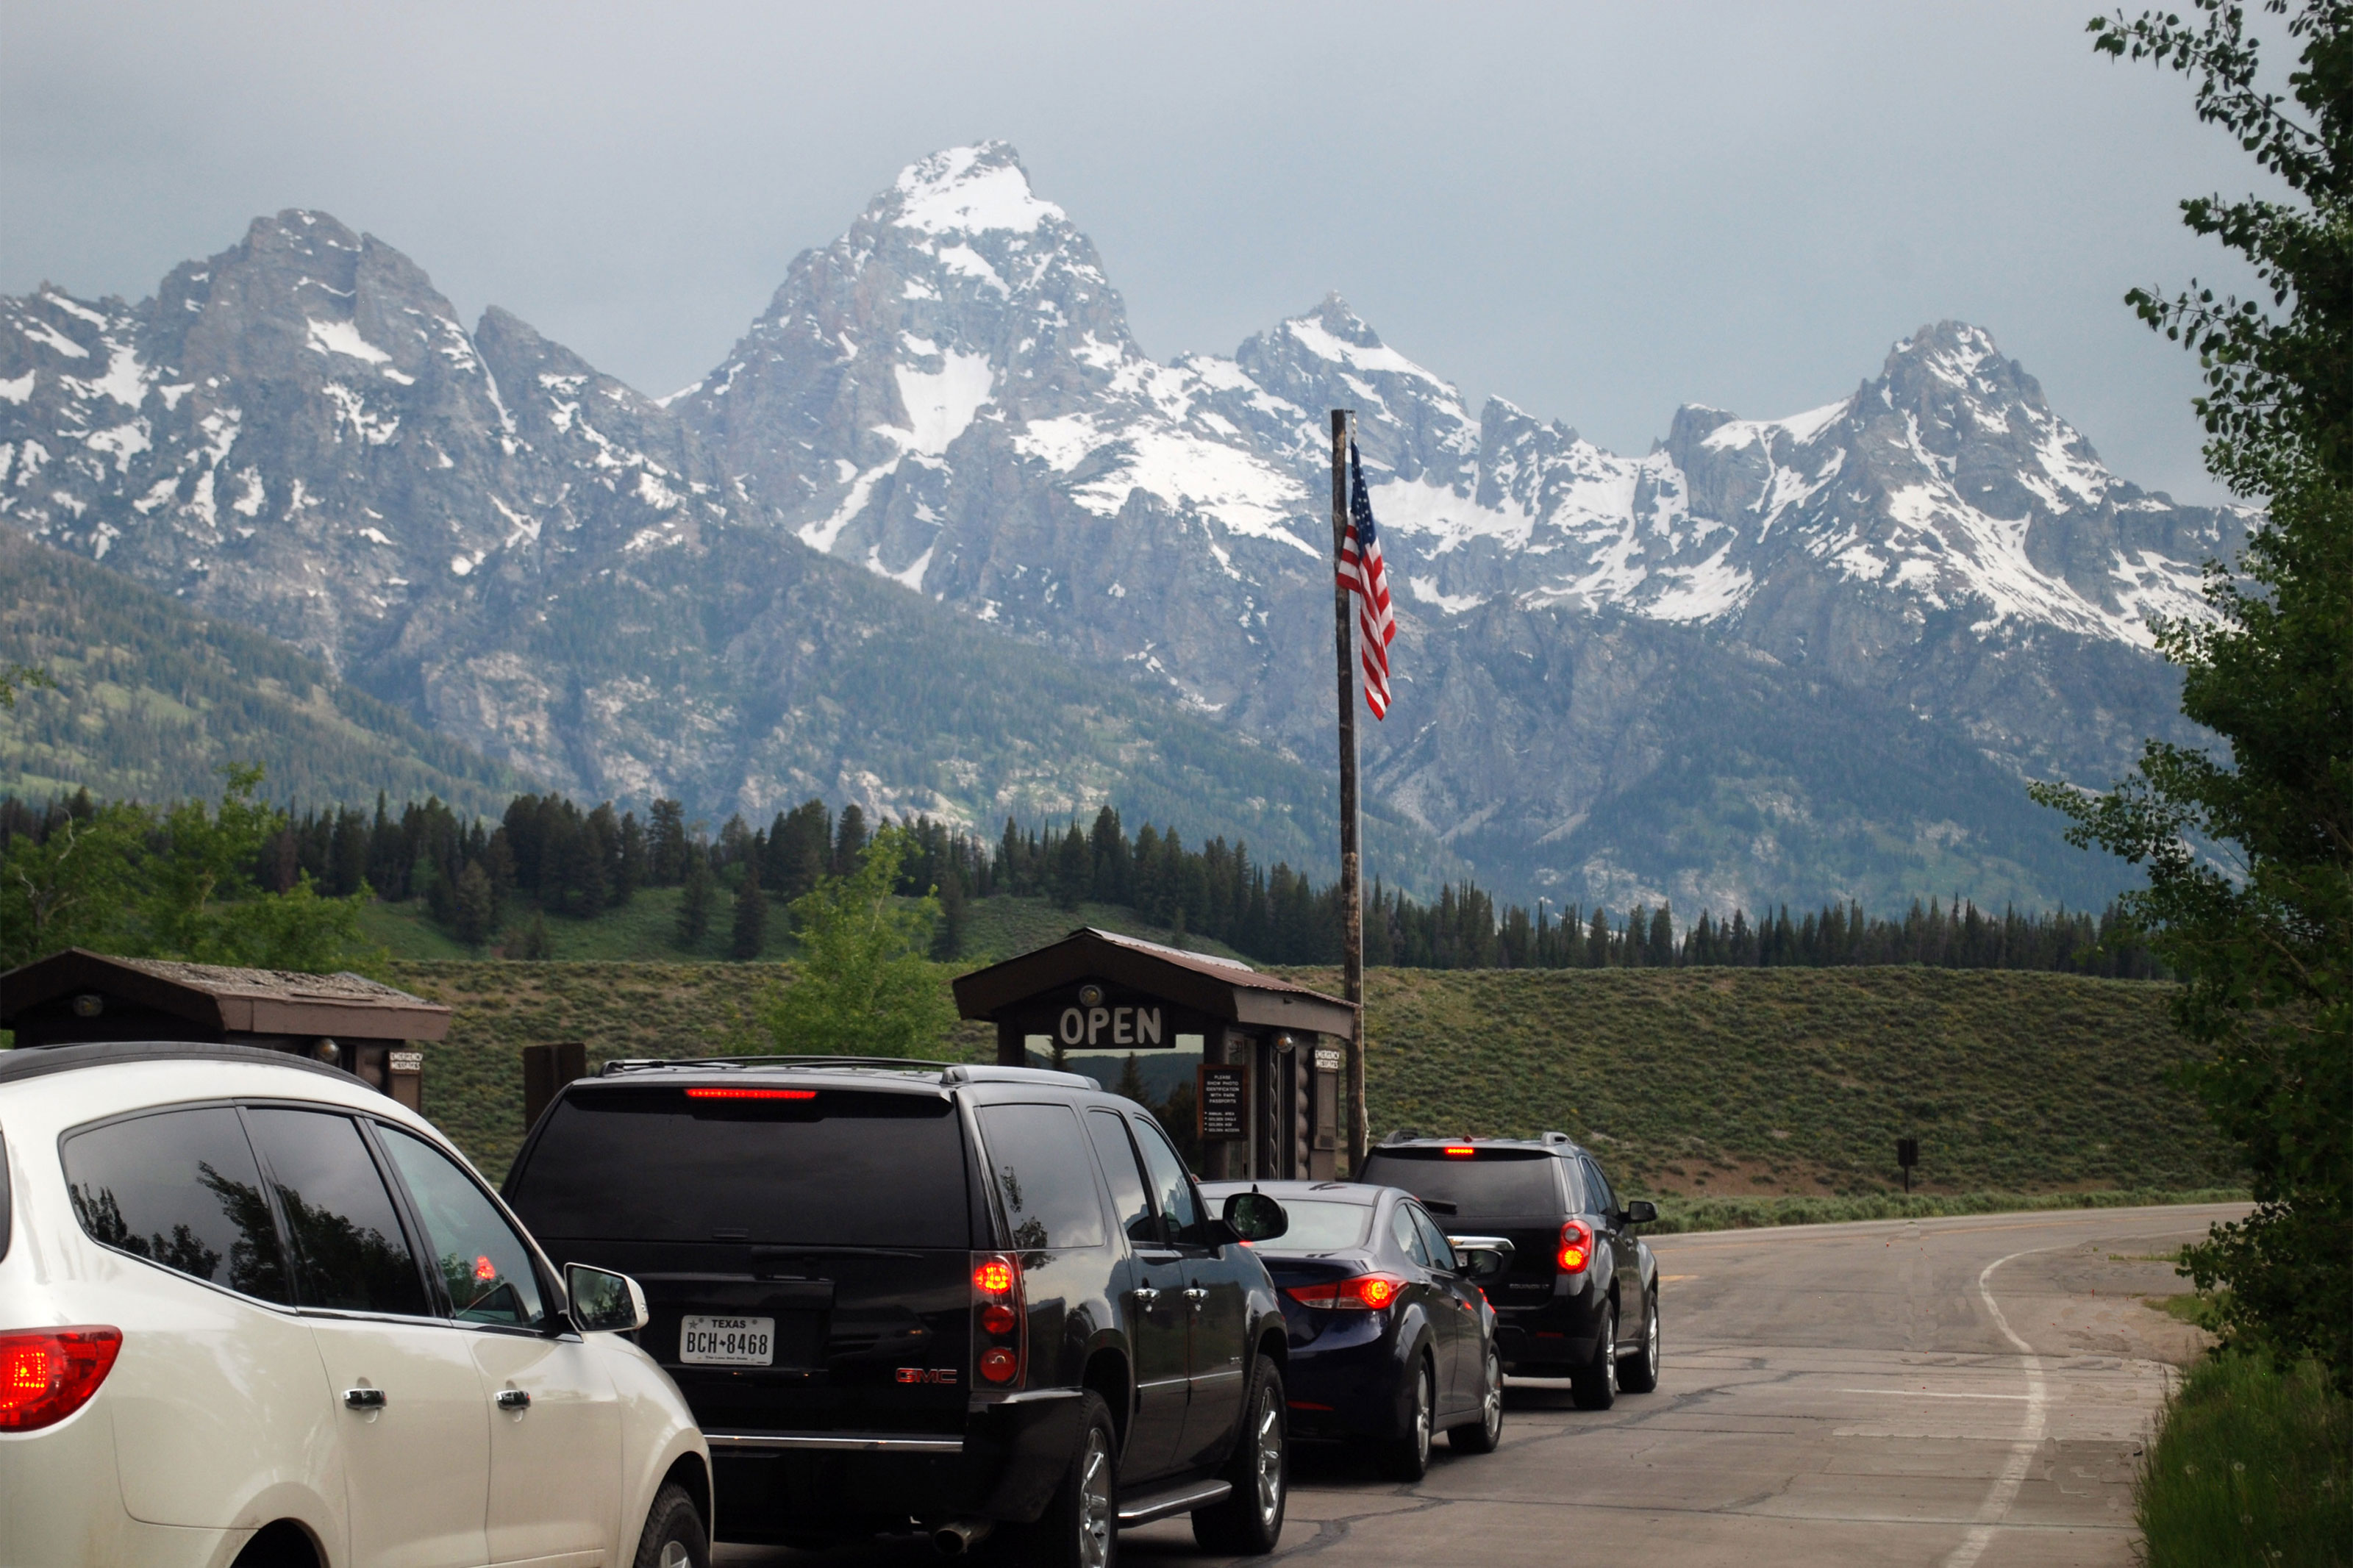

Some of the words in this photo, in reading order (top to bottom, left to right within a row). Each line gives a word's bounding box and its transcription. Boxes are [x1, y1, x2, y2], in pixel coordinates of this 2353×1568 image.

[1060, 1007, 1161, 1045] OPEN
[390, 1052, 424, 1061] EMERGENCY
[1315, 1050, 1340, 1059] EMERGENCY
[391, 1061, 421, 1070] MESSAGES
[1316, 1059, 1338, 1069] MESSAGES
[712, 1320, 746, 1328] TEXAS
[896, 1367, 957, 1383] GMC
